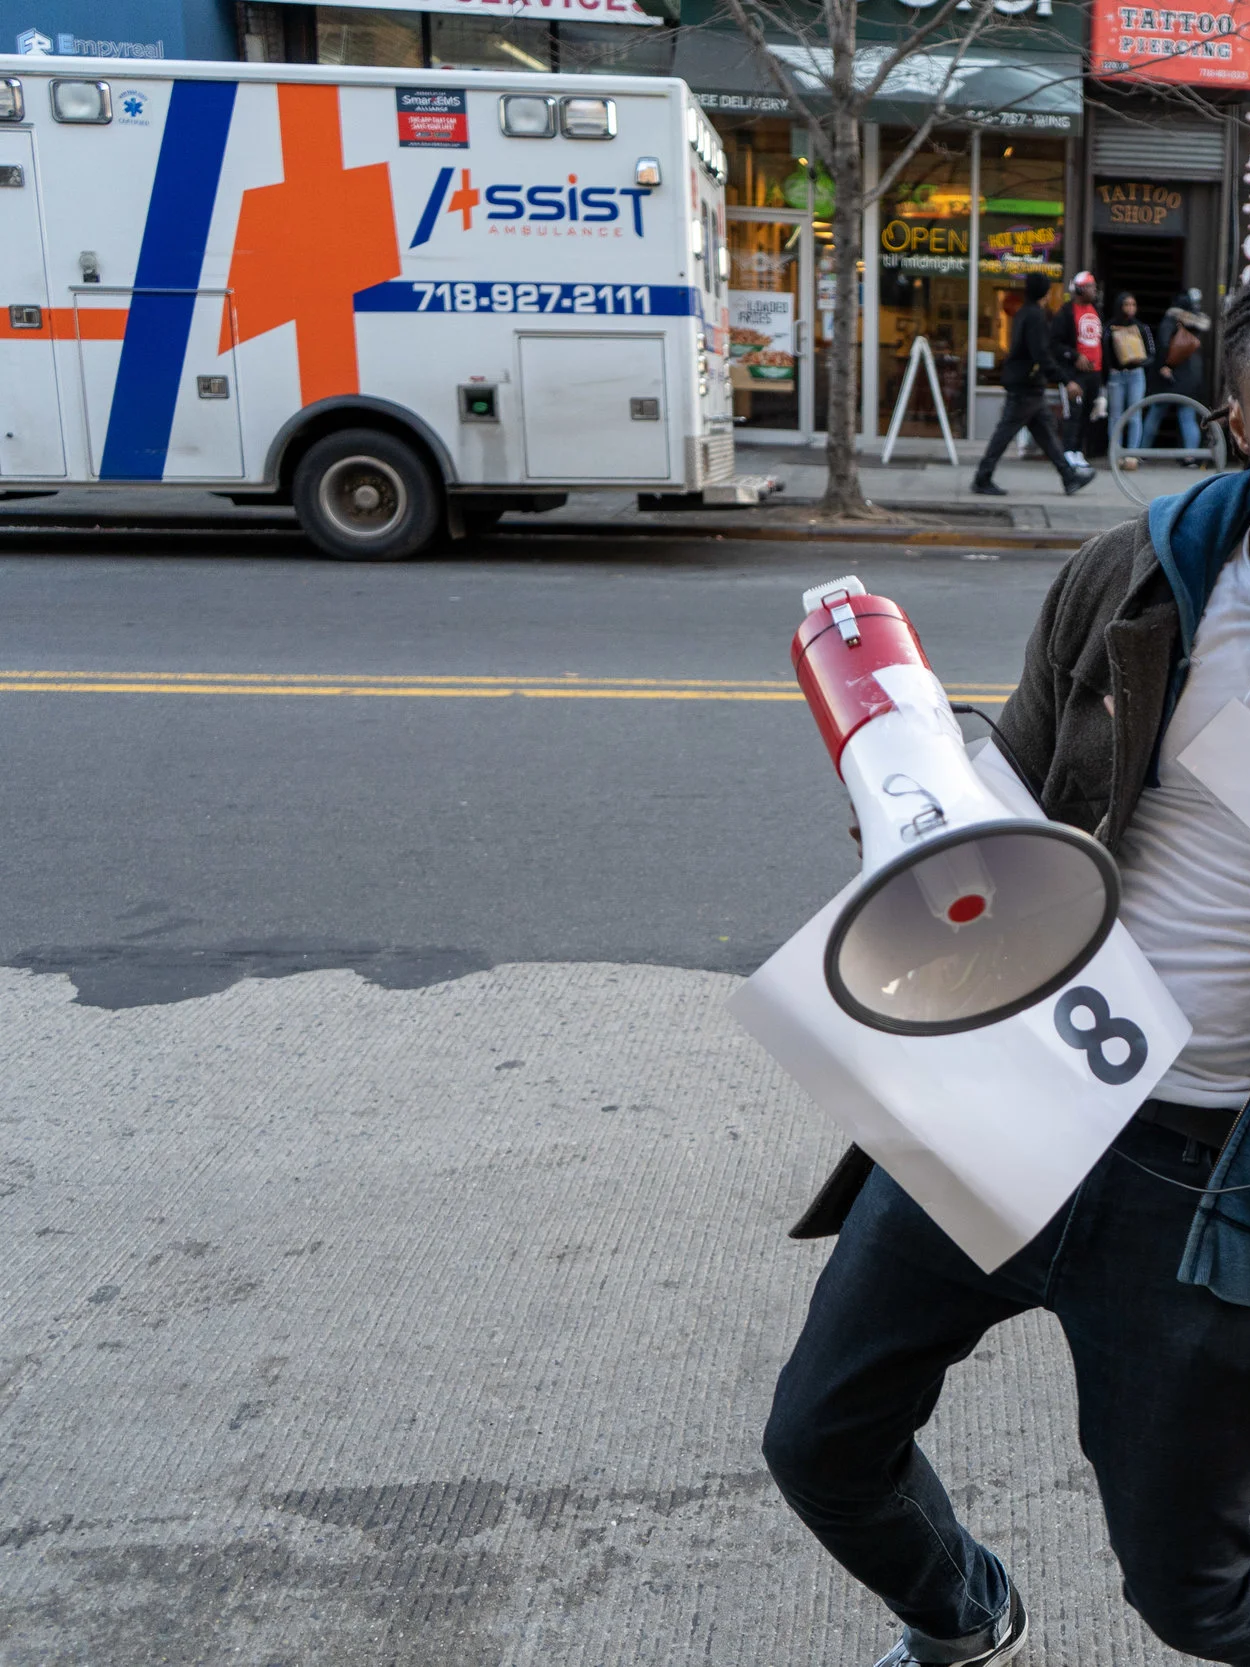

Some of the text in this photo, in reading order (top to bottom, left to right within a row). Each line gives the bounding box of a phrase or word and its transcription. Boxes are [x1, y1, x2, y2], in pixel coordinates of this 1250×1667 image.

[1118, 7, 1236, 35] TATTOO
[58, 33, 164, 58] Empyreal
[1119, 36, 1232, 60] PIERCING
[720, 95, 789, 111] DELIVERY
[1096, 183, 1182, 208] TATTOO
[1111, 204, 1168, 224] SHOP
[488, 224, 624, 238] AMBULANCE
[882, 220, 968, 253] OPEN
[901, 254, 965, 273] midnight
[413, 282, 650, 314] 718-927-2111
[1054, 985, 1148, 1085] 8
